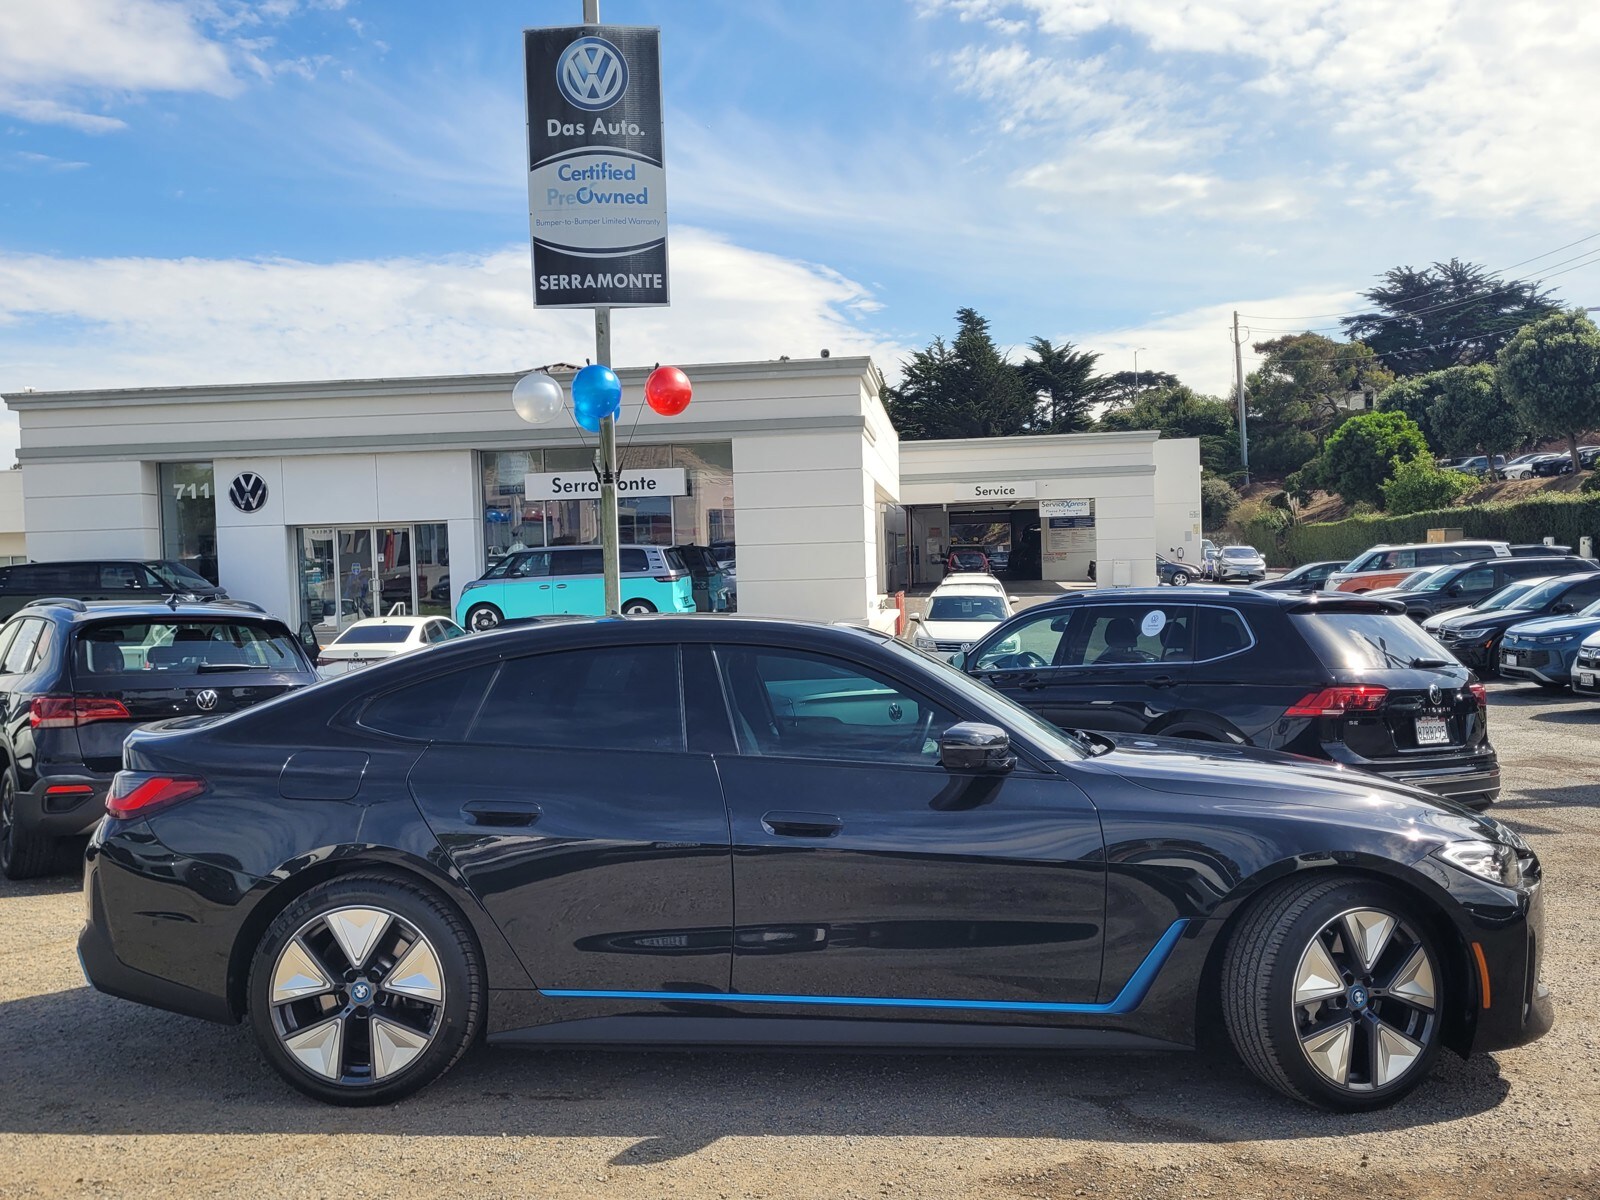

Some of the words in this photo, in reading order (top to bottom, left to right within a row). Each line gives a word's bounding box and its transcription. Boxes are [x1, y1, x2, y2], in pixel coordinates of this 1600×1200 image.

[547, 119, 585, 137] Das
[592, 118, 645, 136] Auto.
[558, 162, 636, 182] Certified
[536, 217, 600, 227] Bumper-to-Bumper
[602, 217, 627, 226] Limited
[628, 217, 660, 226] Warranty
[540, 273, 663, 290] SERRAMONTE
[173, 482, 210, 500] 711
[551, 476, 657, 494] Serraonte
[975, 486, 1016, 496] Service
